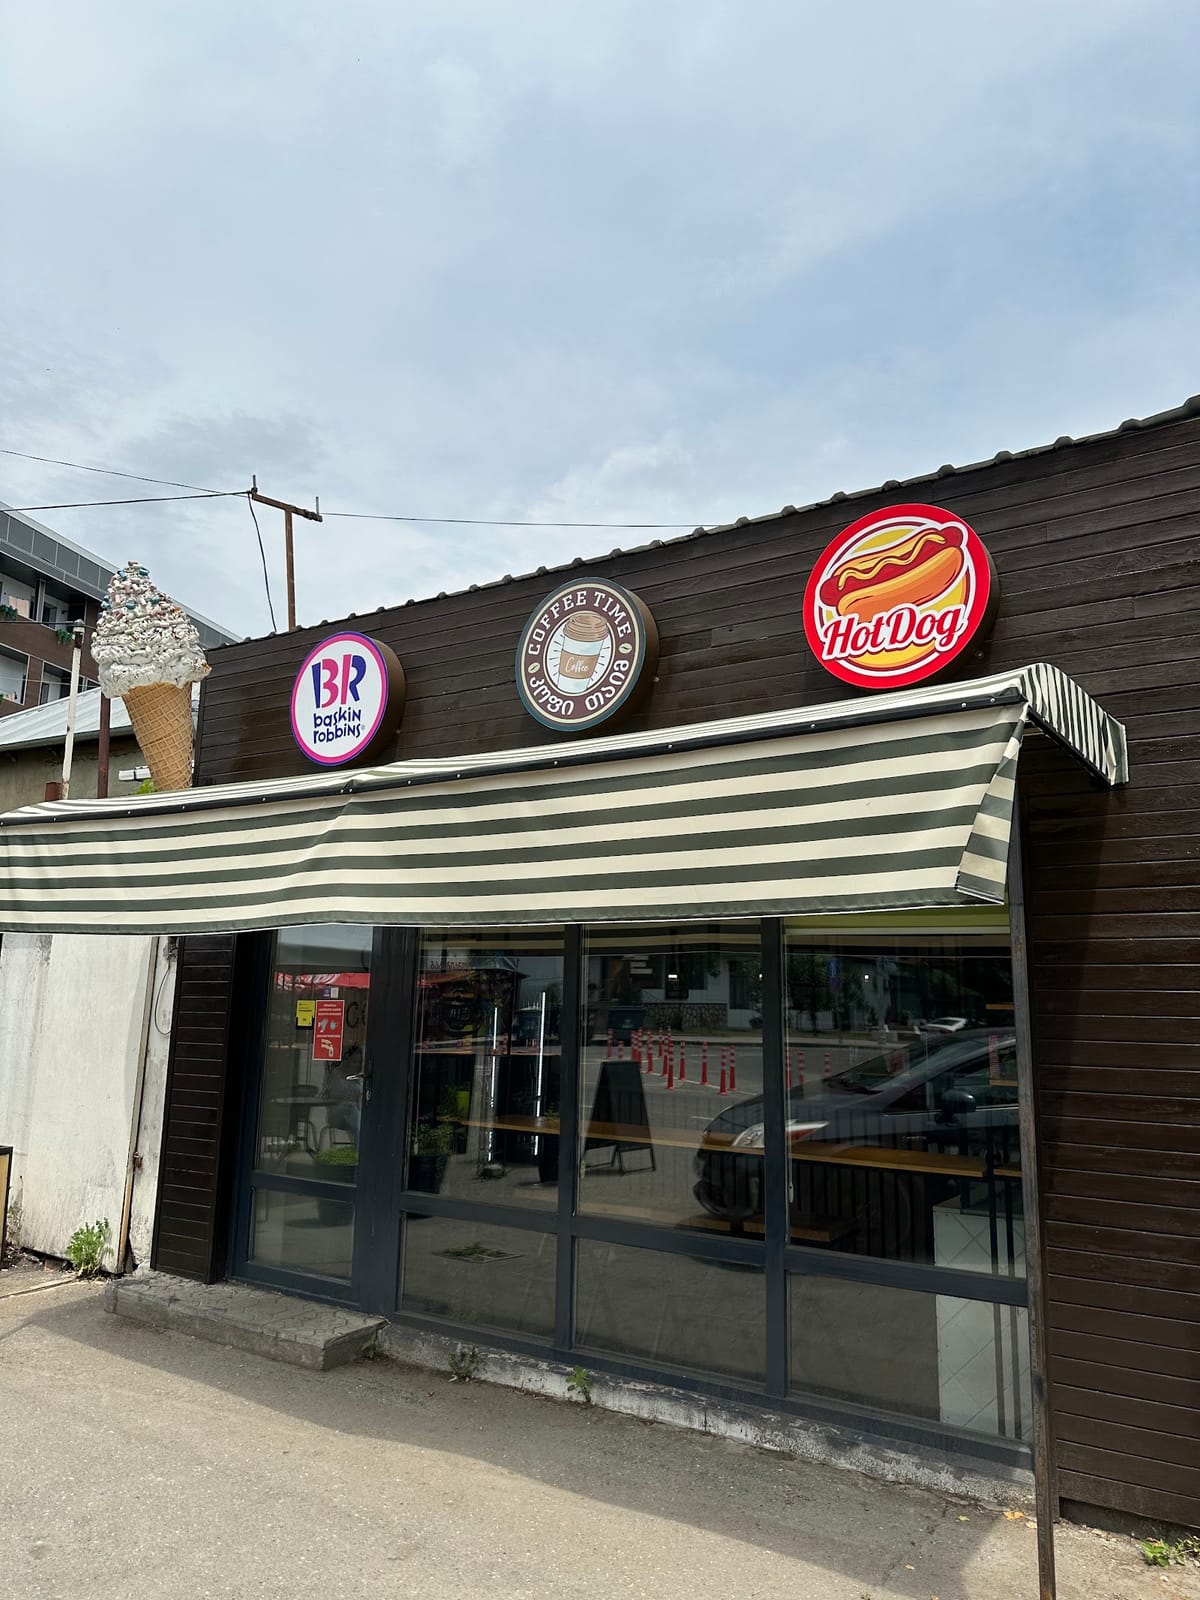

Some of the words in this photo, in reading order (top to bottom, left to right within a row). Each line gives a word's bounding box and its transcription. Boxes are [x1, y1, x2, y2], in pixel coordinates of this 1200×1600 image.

[528, 590, 587, 655] COFFEE
[594, 592, 632, 638] TIME
[311, 653, 367, 709] BR
[529, 676, 574, 715] კოფი
[585, 659, 630, 711] თაიმ
